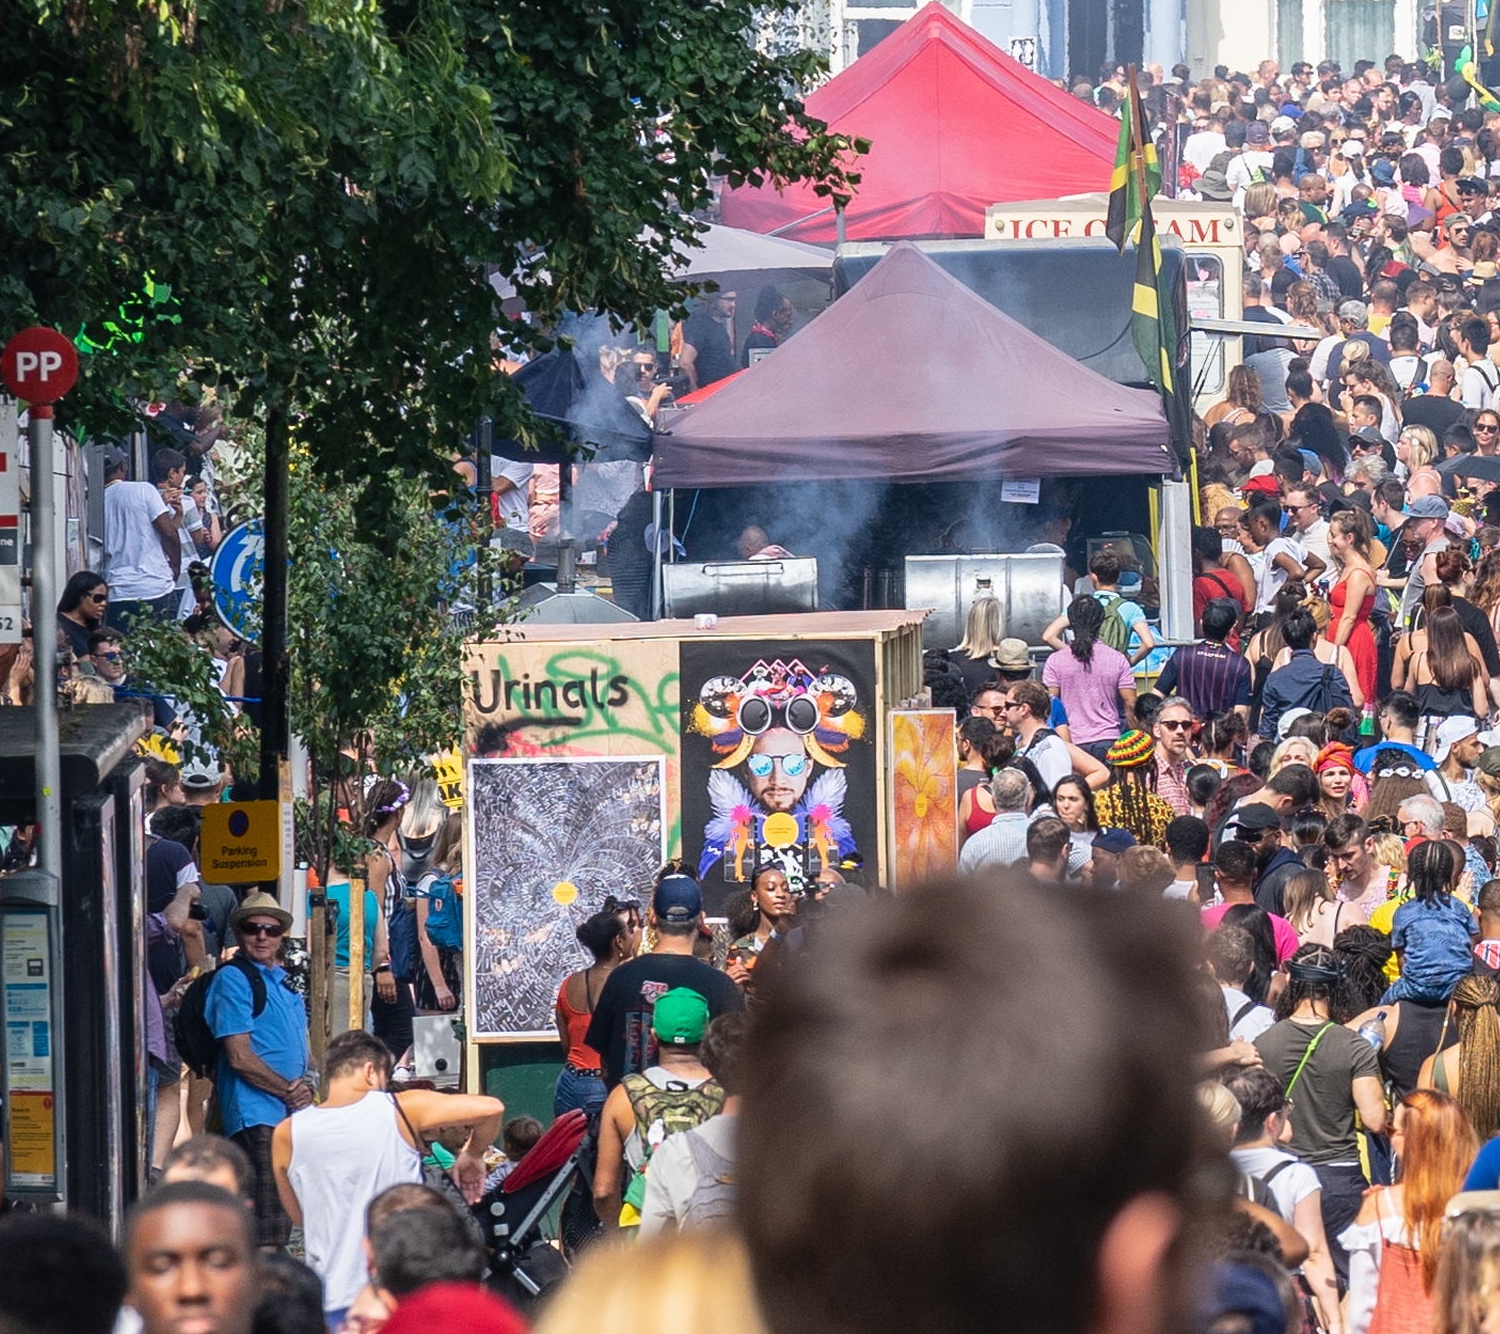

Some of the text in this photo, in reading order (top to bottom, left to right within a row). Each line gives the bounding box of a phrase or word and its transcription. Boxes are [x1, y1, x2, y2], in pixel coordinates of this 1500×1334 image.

[1009, 218, 1222, 243] ICE CAM
[16, 351, 62, 382] PP
[471, 666, 630, 714] Urinals
[221, 845, 258, 857] Parking
[211, 858, 268, 870] Suspension
